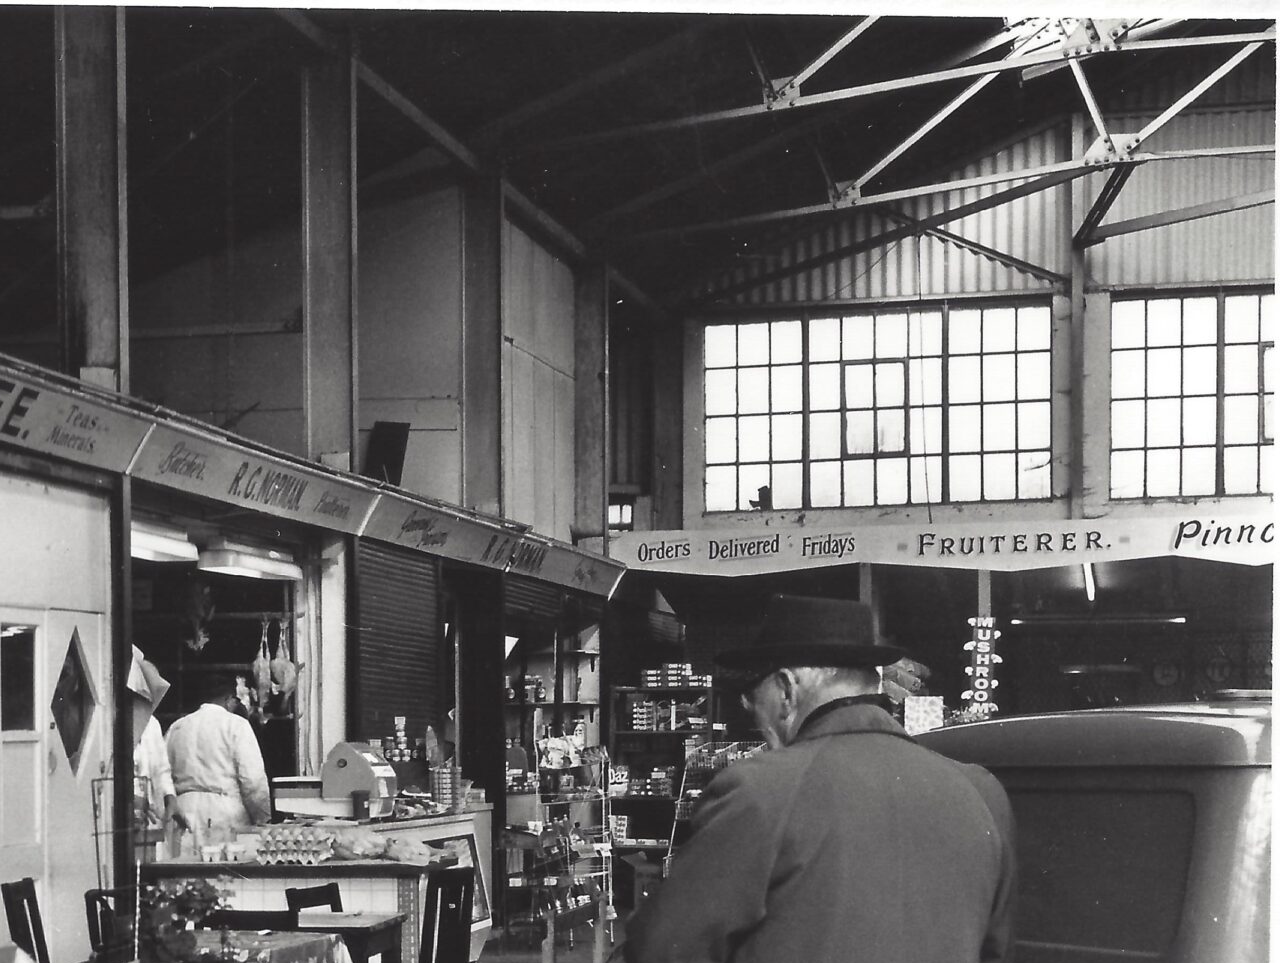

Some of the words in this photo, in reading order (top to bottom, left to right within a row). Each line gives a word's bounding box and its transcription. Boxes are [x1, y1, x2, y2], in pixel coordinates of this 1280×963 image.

[638, 541, 691, 562] Orders
[709, 534, 780, 561] Delivered
[802, 533, 855, 559] Fridays
[608, 768, 628, 784] Daz
